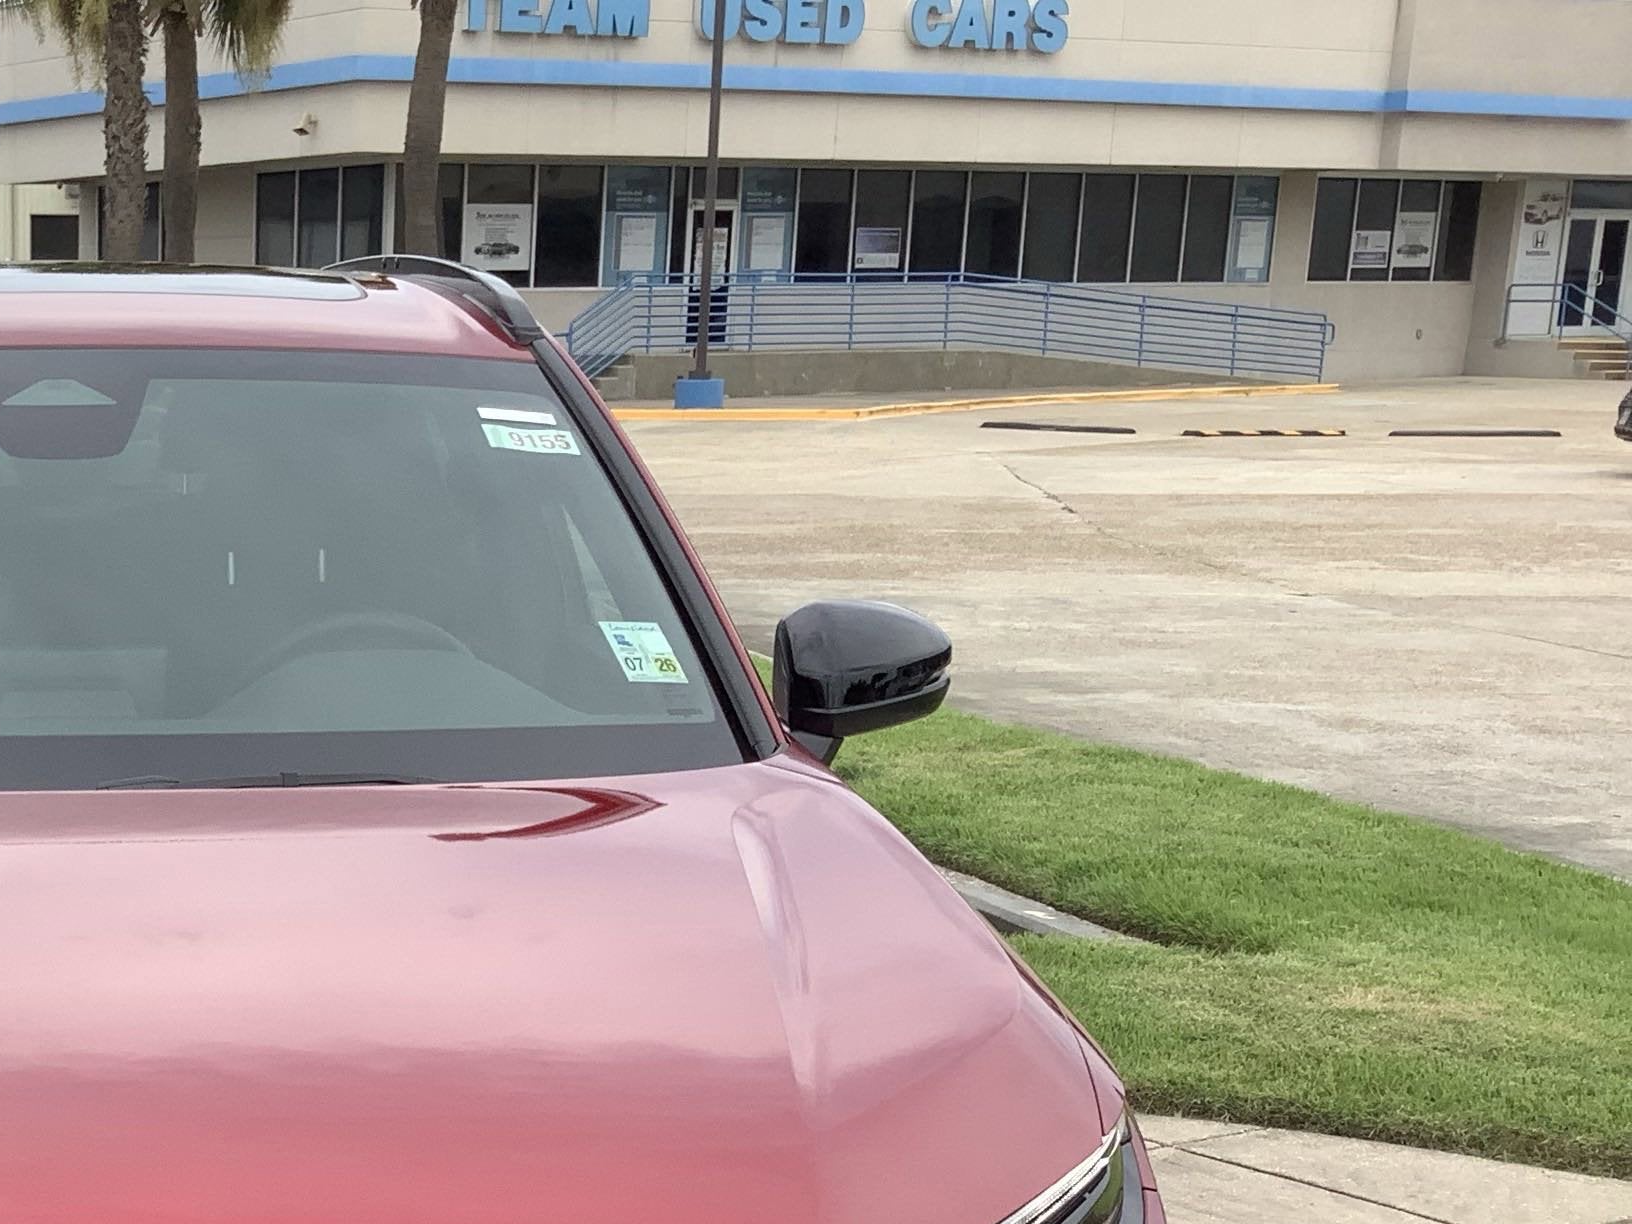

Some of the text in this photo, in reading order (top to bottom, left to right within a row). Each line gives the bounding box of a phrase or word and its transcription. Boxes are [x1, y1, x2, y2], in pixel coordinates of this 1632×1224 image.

[695, 0, 865, 45] USED
[908, 0, 1070, 54] CARS
[508, 432, 571, 449] 9155
[624, 657, 678, 673] 07 26
